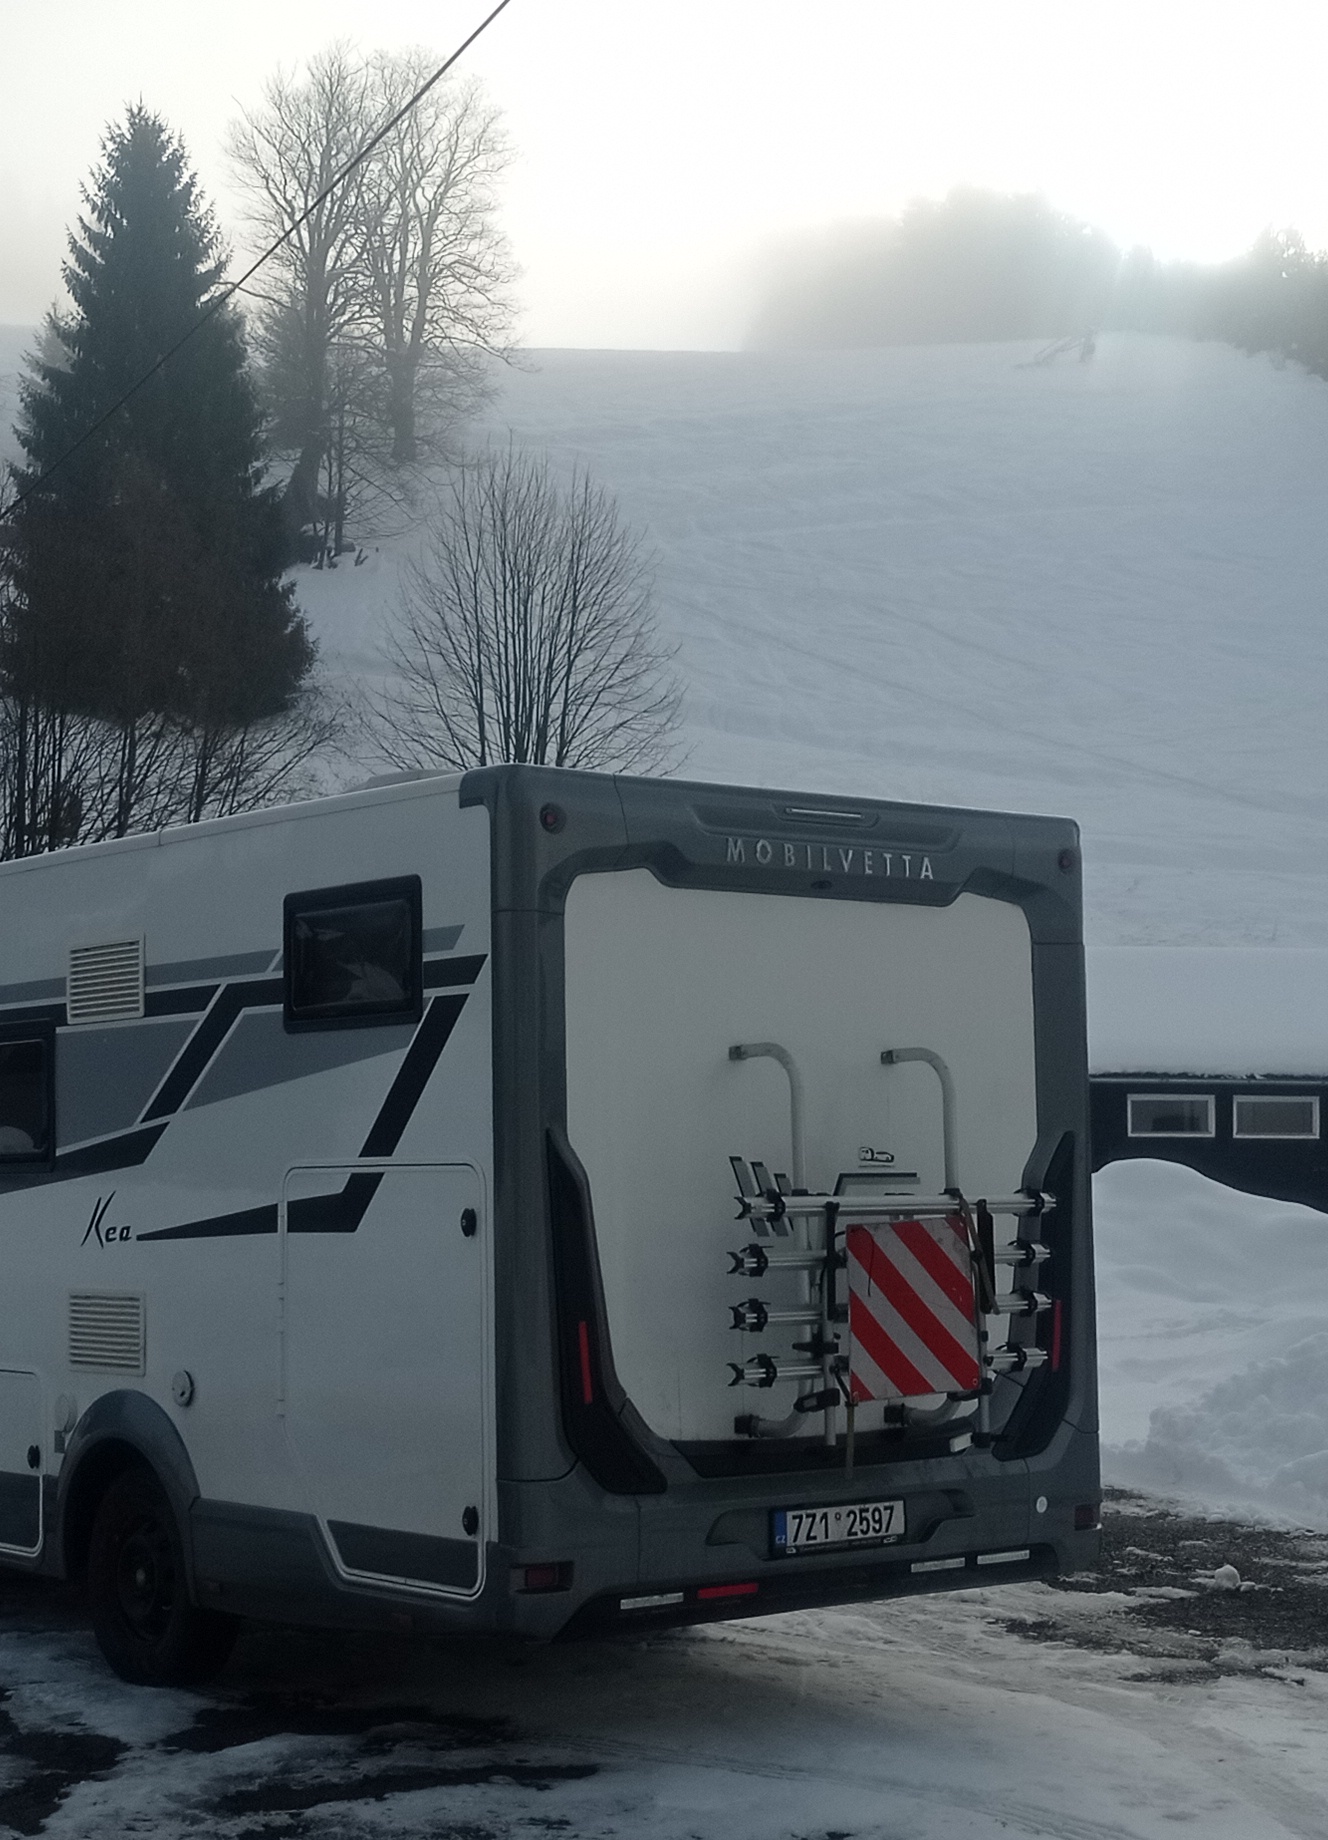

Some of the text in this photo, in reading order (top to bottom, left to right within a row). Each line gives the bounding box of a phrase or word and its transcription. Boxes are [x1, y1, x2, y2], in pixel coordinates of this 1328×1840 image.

[726, 837, 933, 880] MOBILVETTA
[80, 1190, 132, 1249] Kea
[775, 1535, 786, 1544] CZ
[792, 1505, 894, 1543] 7Z1 2597
